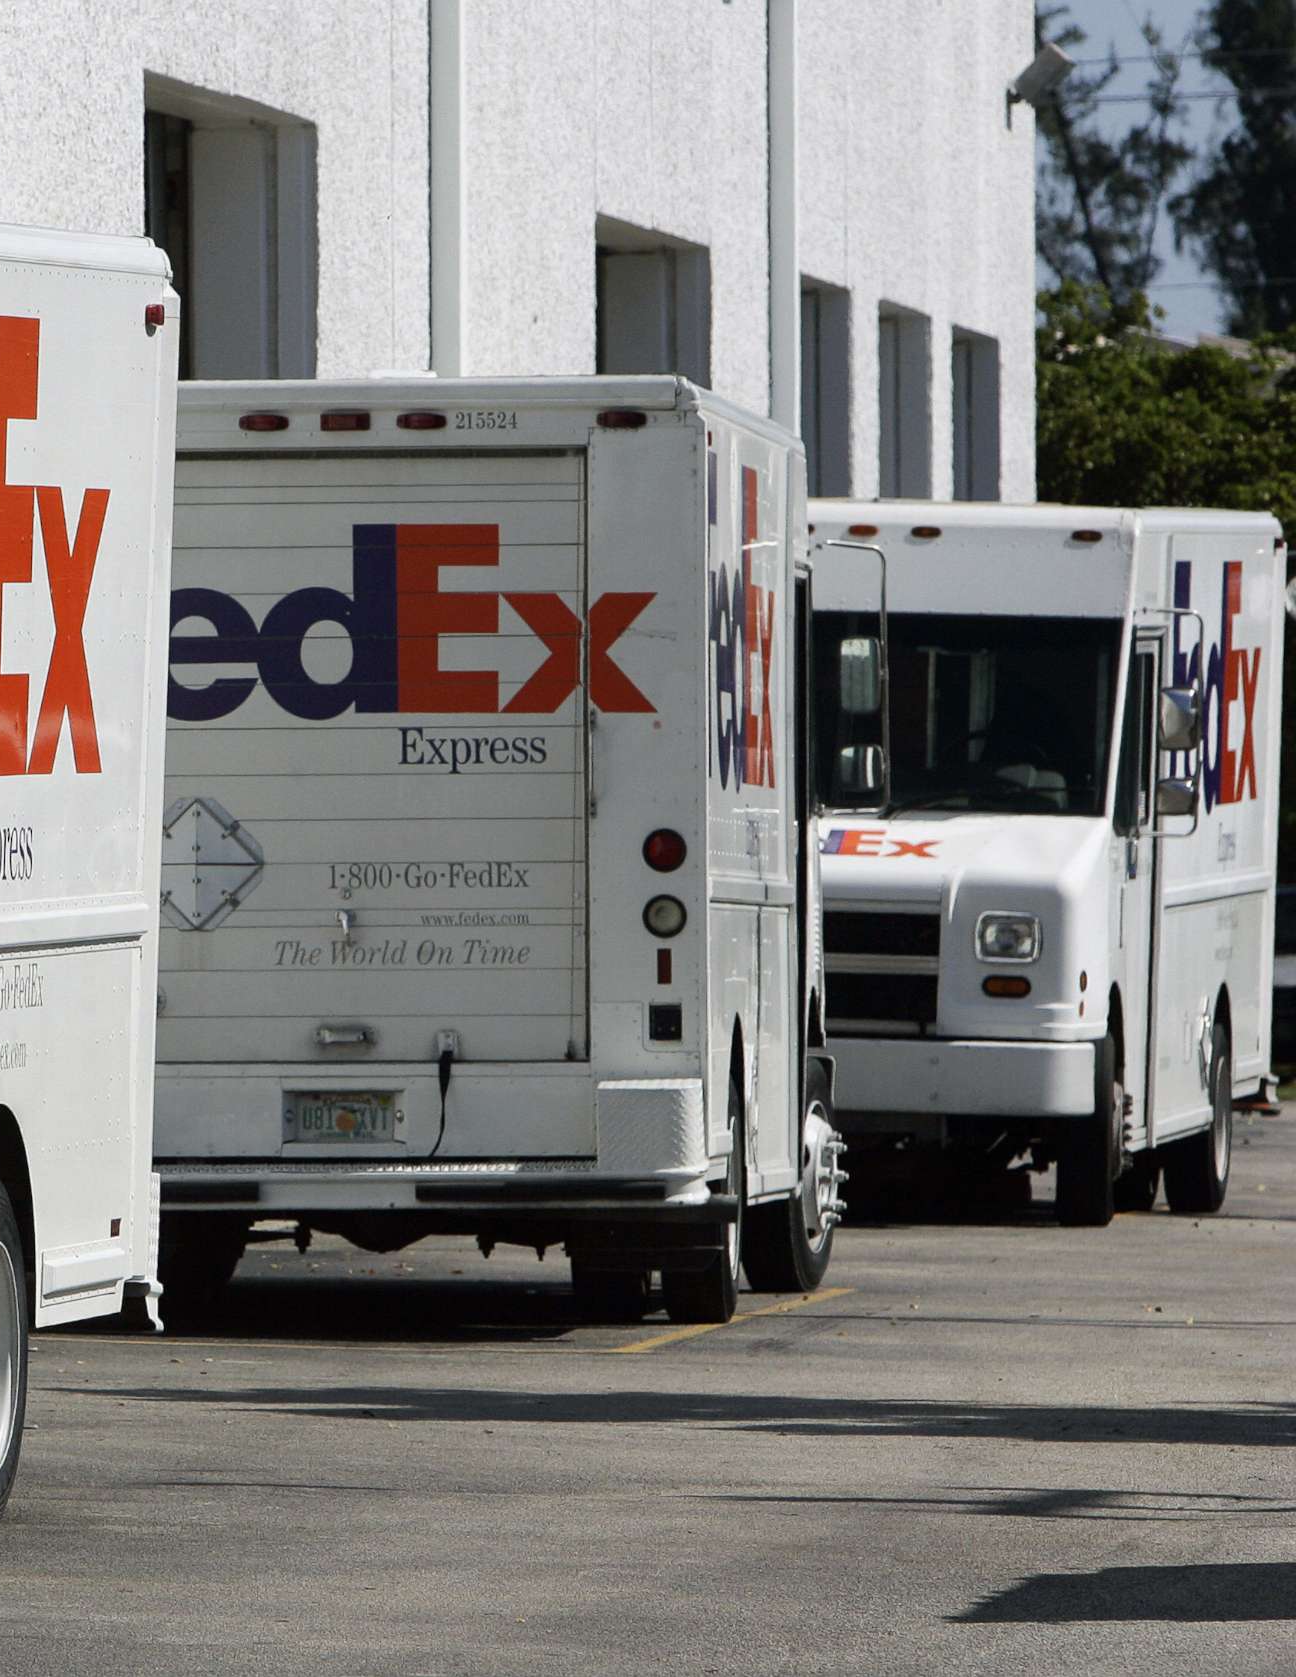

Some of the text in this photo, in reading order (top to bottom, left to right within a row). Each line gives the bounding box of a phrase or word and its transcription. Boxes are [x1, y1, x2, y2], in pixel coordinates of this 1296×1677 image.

[455, 412, 518, 430] 215524
[166, 524, 659, 721] edEx
[398, 727, 548, 774] Express
[420, 912, 530, 927] www.fedex.com
[274, 939, 531, 966] The World On Time
